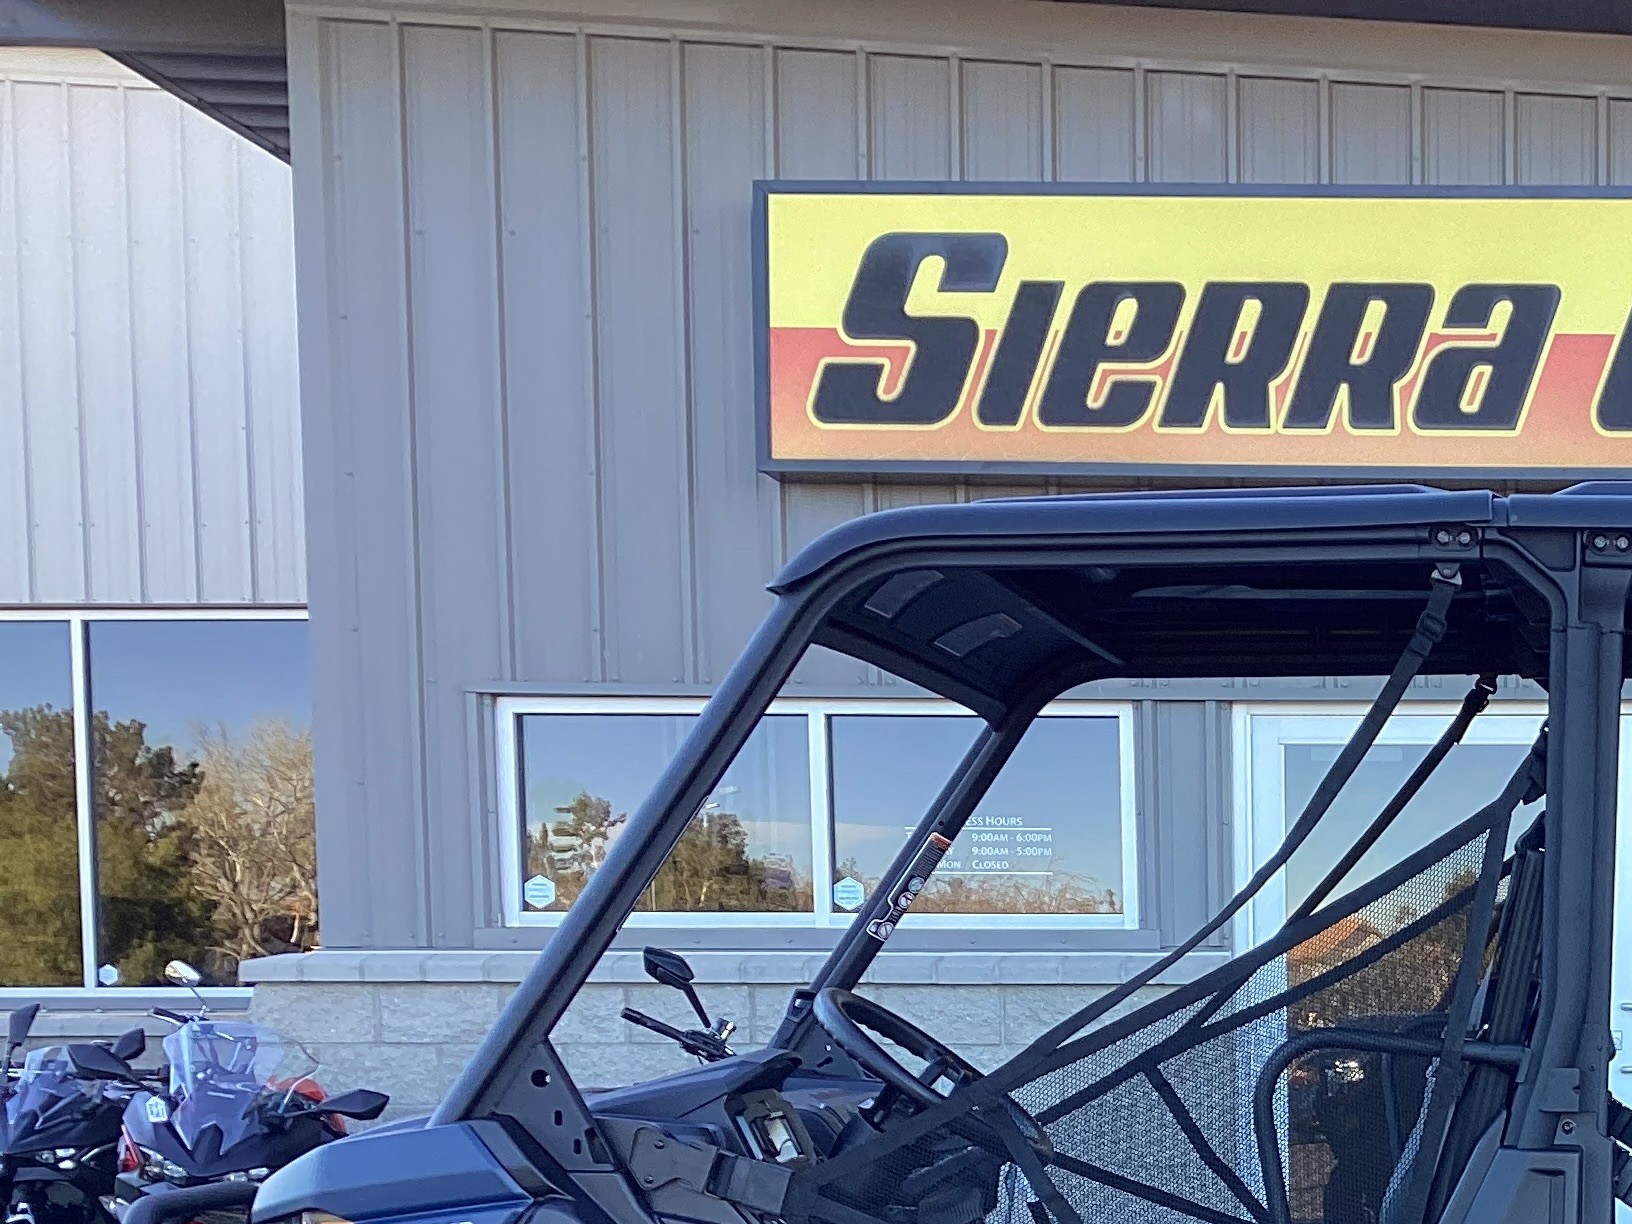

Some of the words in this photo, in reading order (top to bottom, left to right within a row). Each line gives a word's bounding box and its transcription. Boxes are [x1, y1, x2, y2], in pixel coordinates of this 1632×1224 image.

[810, 230, 1563, 432] Sierra
[971, 833, 1009, 842] 9:00AM
[971, 847, 1009, 856] 9:00AM
